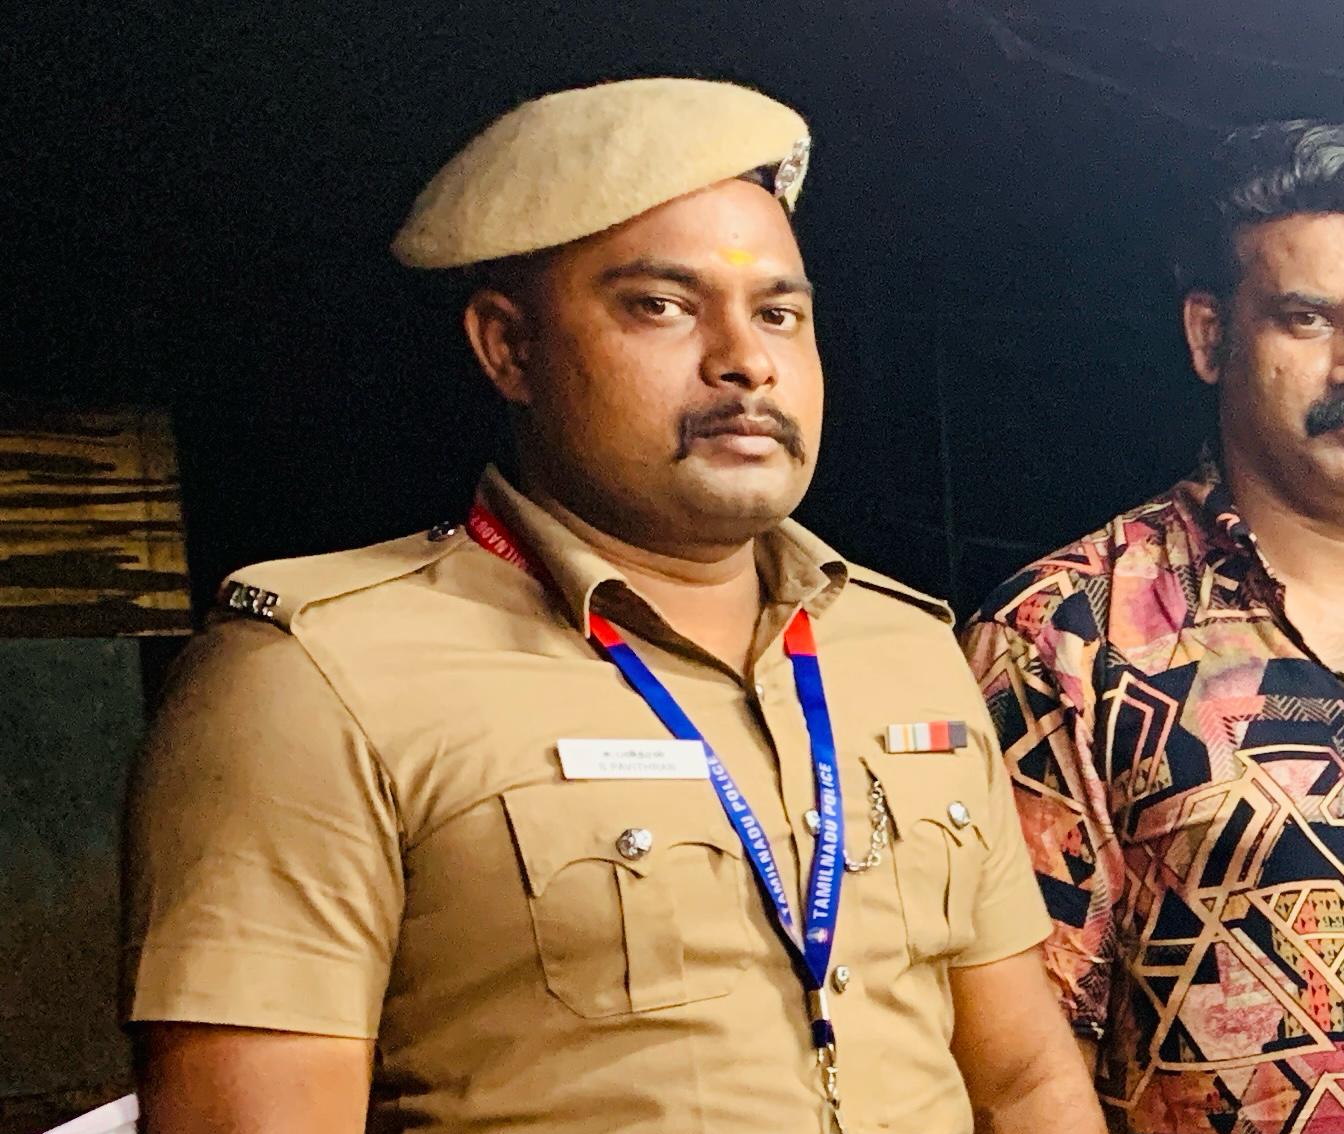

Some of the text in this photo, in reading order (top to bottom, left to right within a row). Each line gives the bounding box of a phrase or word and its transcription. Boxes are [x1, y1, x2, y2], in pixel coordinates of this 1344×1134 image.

[740, 815, 790, 916] TAMILNADU
[813, 762, 838, 919] TAMILNADU POLICE
